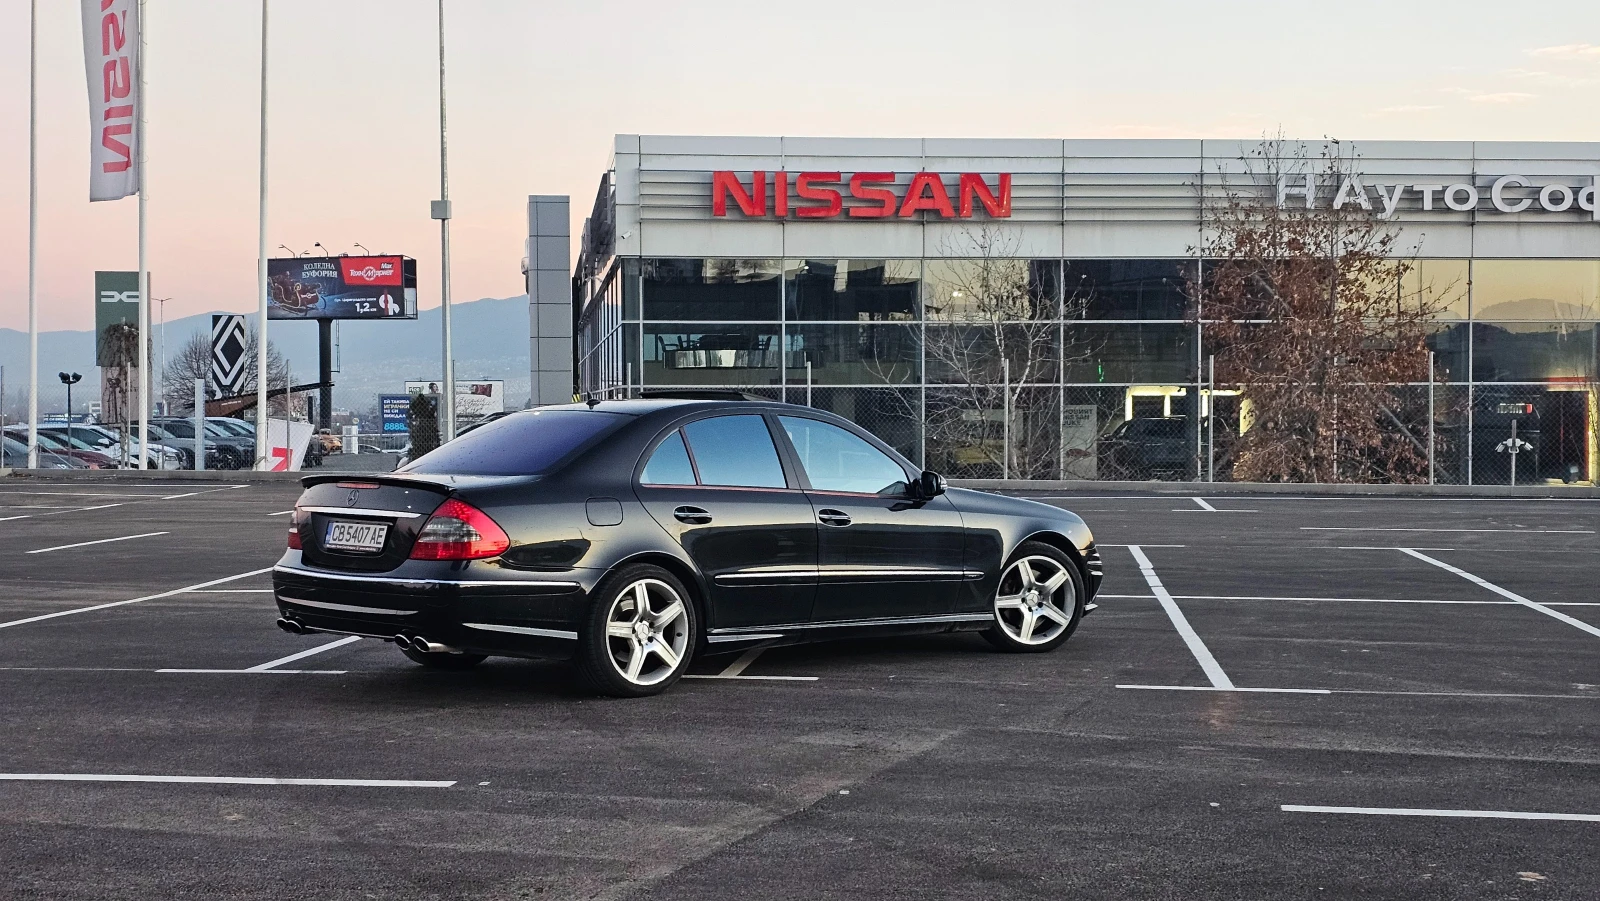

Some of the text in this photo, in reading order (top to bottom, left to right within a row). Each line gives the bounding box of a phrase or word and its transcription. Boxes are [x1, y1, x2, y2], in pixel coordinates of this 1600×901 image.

[712, 170, 1012, 218] NISSAN
[1332, 173, 1479, 220] Ауто
[303, 262, 336, 270] КОЛЕДНА
[355, 302, 370, 313] 1,2
[331, 525, 346, 542] CB
[345, 526, 371, 544] 5407
[369, 527, 385, 545] AE
